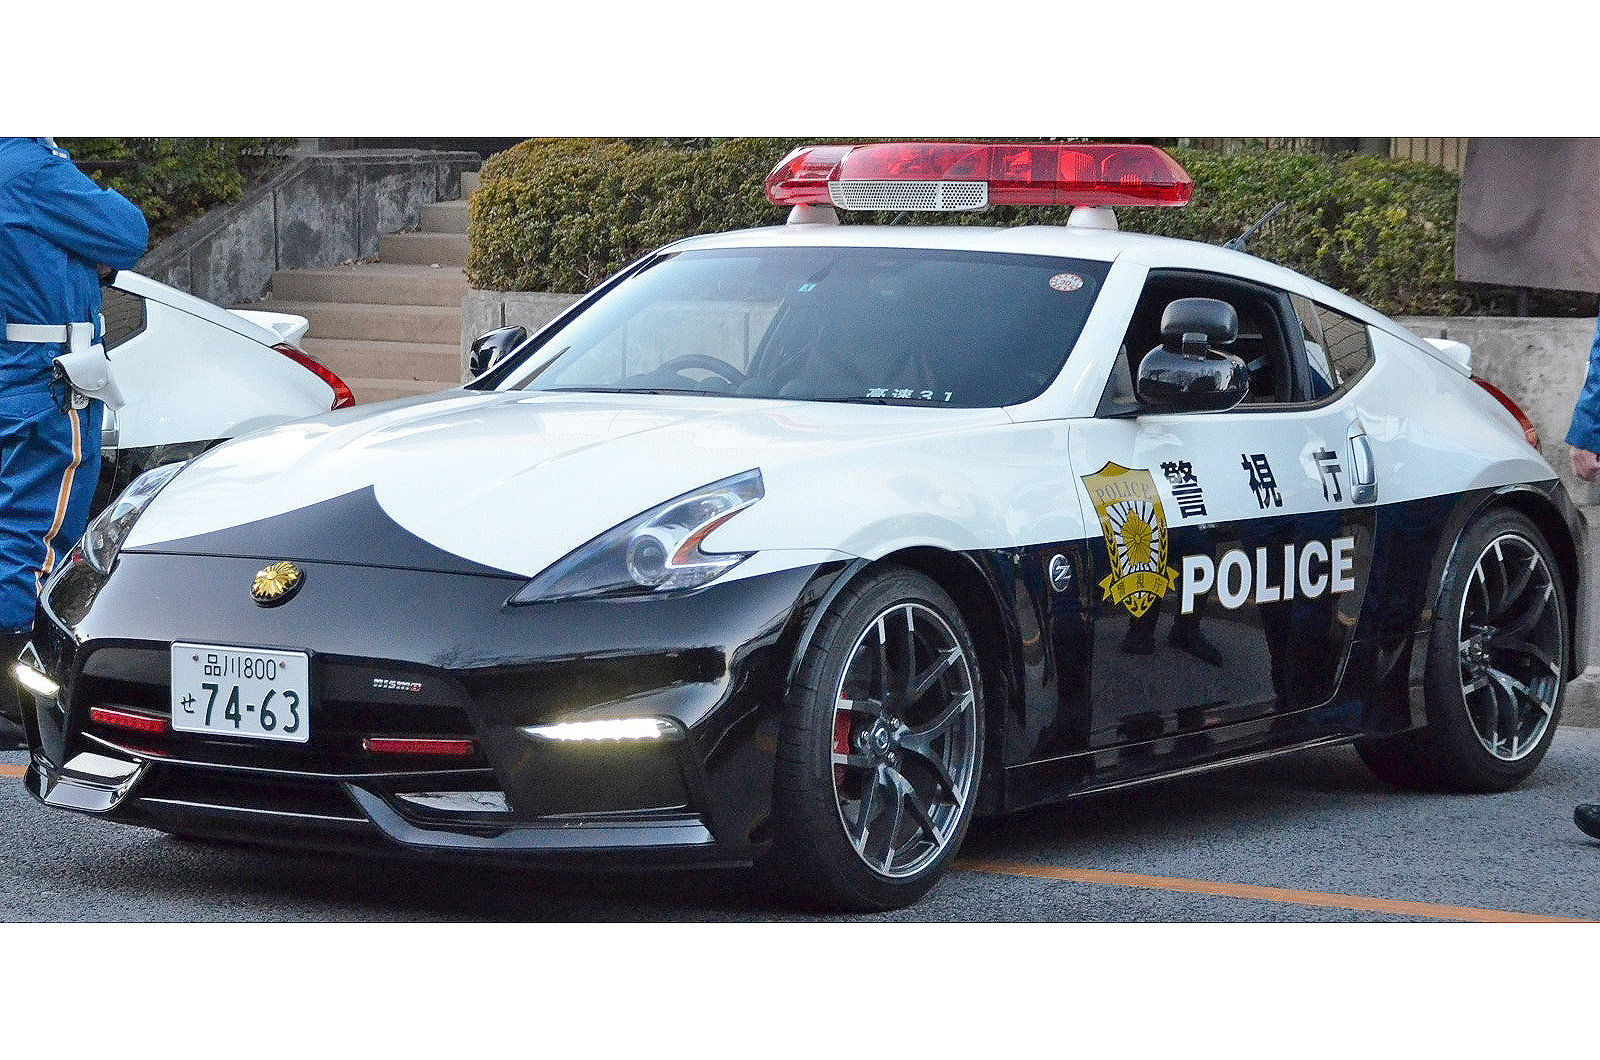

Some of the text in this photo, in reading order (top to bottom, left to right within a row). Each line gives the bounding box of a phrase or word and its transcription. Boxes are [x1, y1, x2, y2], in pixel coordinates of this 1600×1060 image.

[1095, 481, 1153, 505] POLICE
[1160, 446, 1343, 518] 警視庁
[1181, 537, 1355, 615] POLICE
[180, 682, 300, 733] せ 74-63
